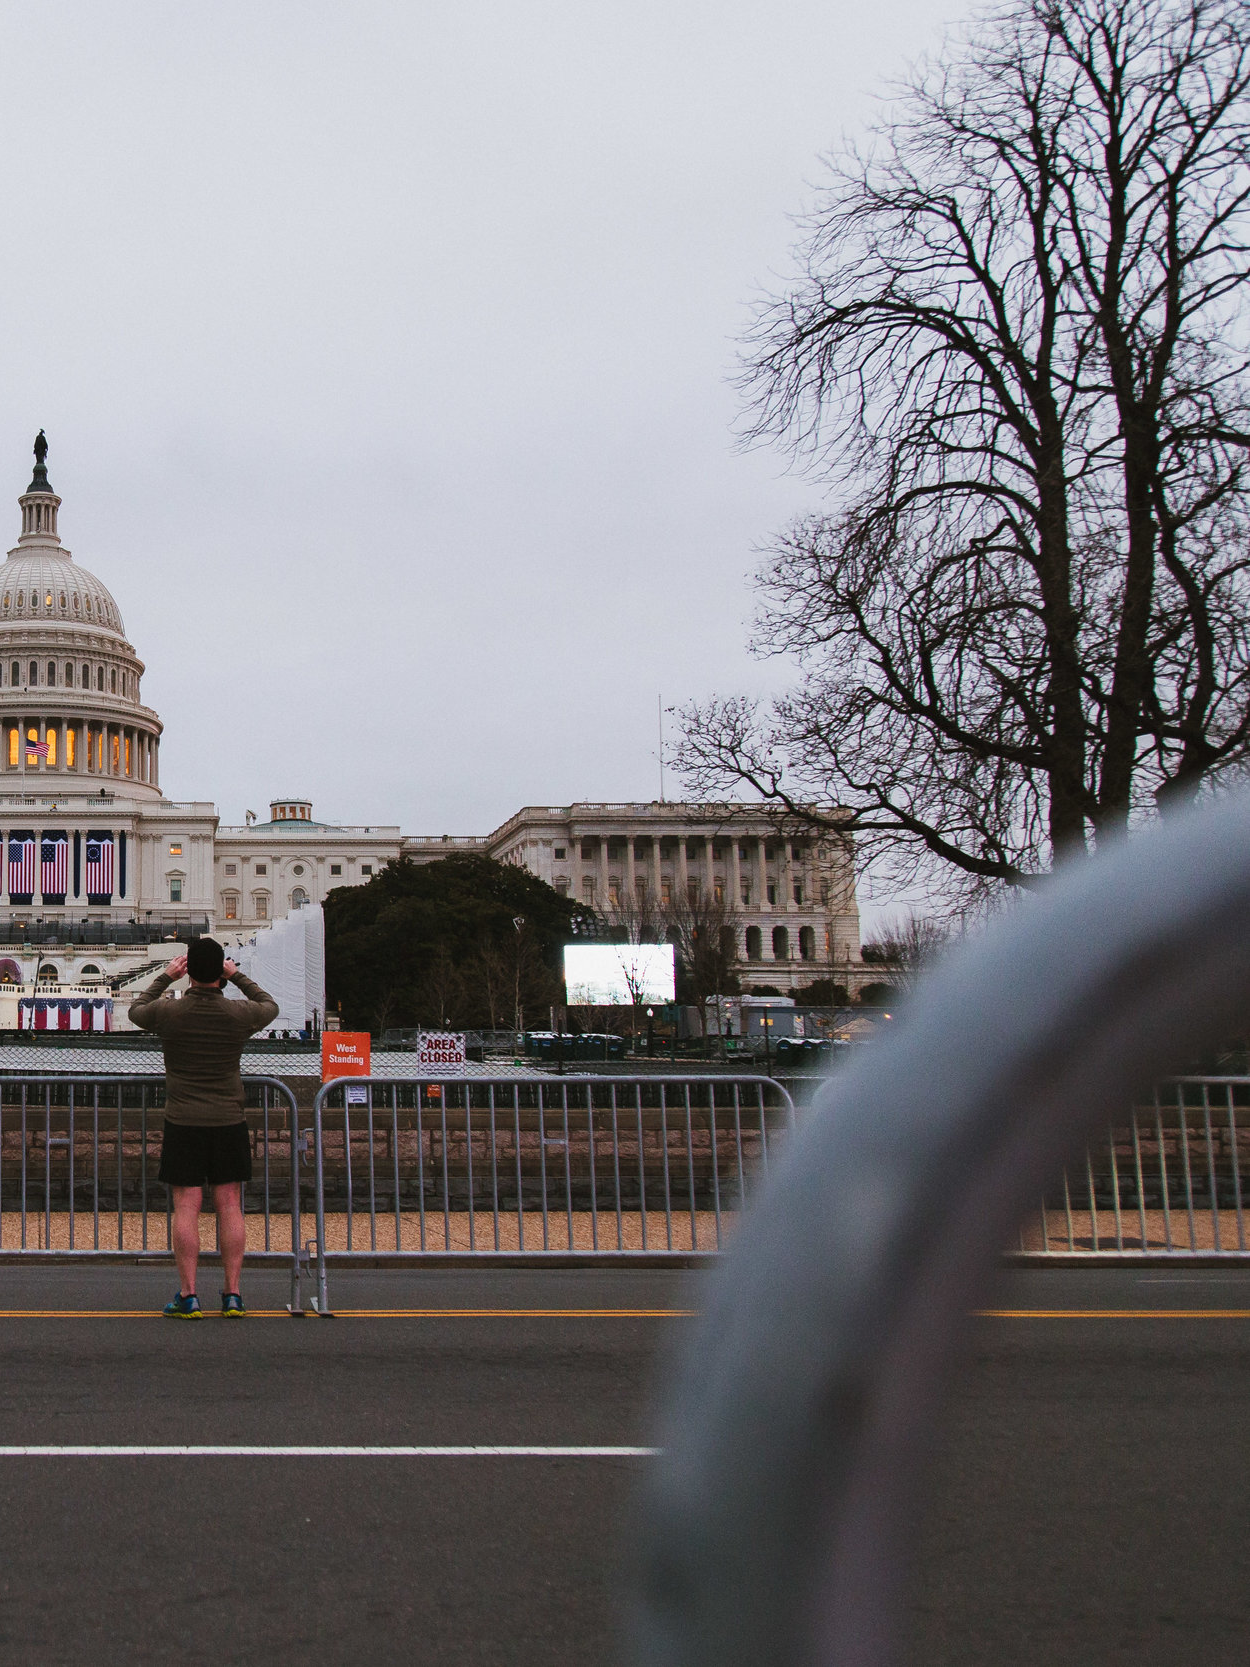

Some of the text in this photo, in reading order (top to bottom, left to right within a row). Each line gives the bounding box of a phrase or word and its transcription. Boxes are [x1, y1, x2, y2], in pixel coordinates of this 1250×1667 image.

[336, 1043, 357, 1053] West
[426, 1039, 456, 1050] AREA
[329, 1054, 364, 1066] Standing
[420, 1051, 462, 1063] CLOSED
